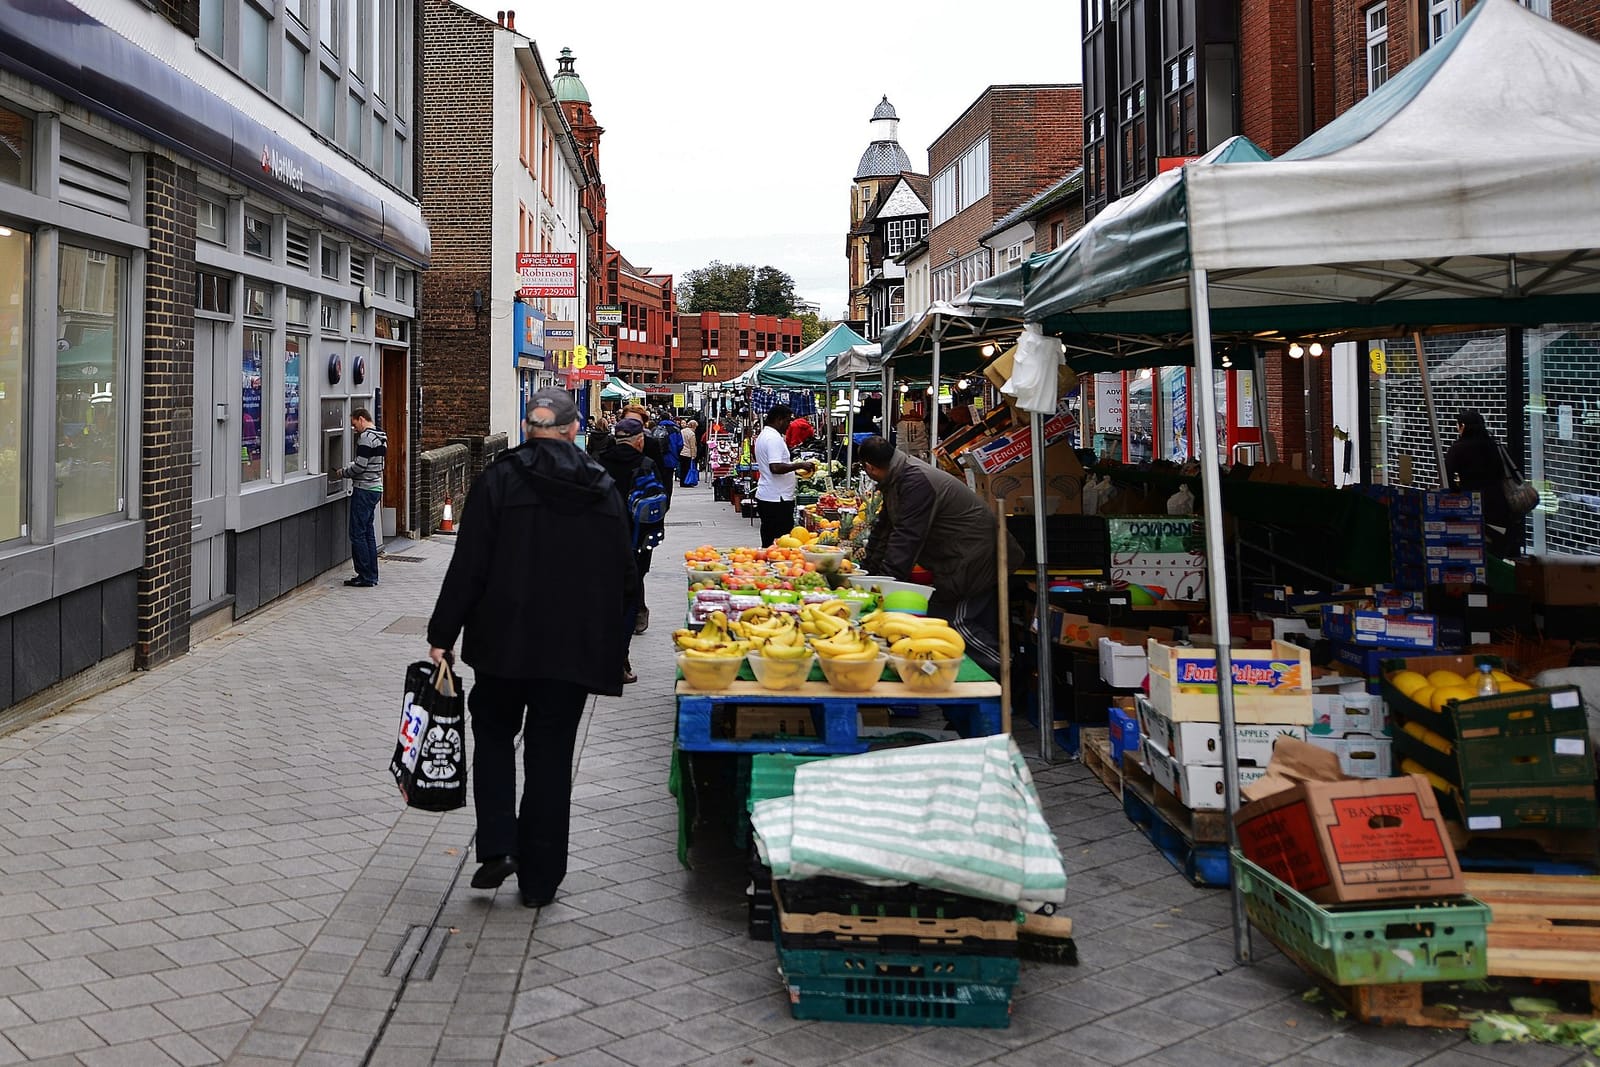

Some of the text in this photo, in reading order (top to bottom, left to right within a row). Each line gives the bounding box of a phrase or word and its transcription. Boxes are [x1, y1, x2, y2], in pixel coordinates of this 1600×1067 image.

[271, 149, 304, 193] NatWest
[520, 257, 573, 265] OFFICES TO LET
[522, 267, 574, 277] Robinsons
[520, 288, 575, 296] 01737 229200
[1129, 522, 1193, 537] KROMCO
